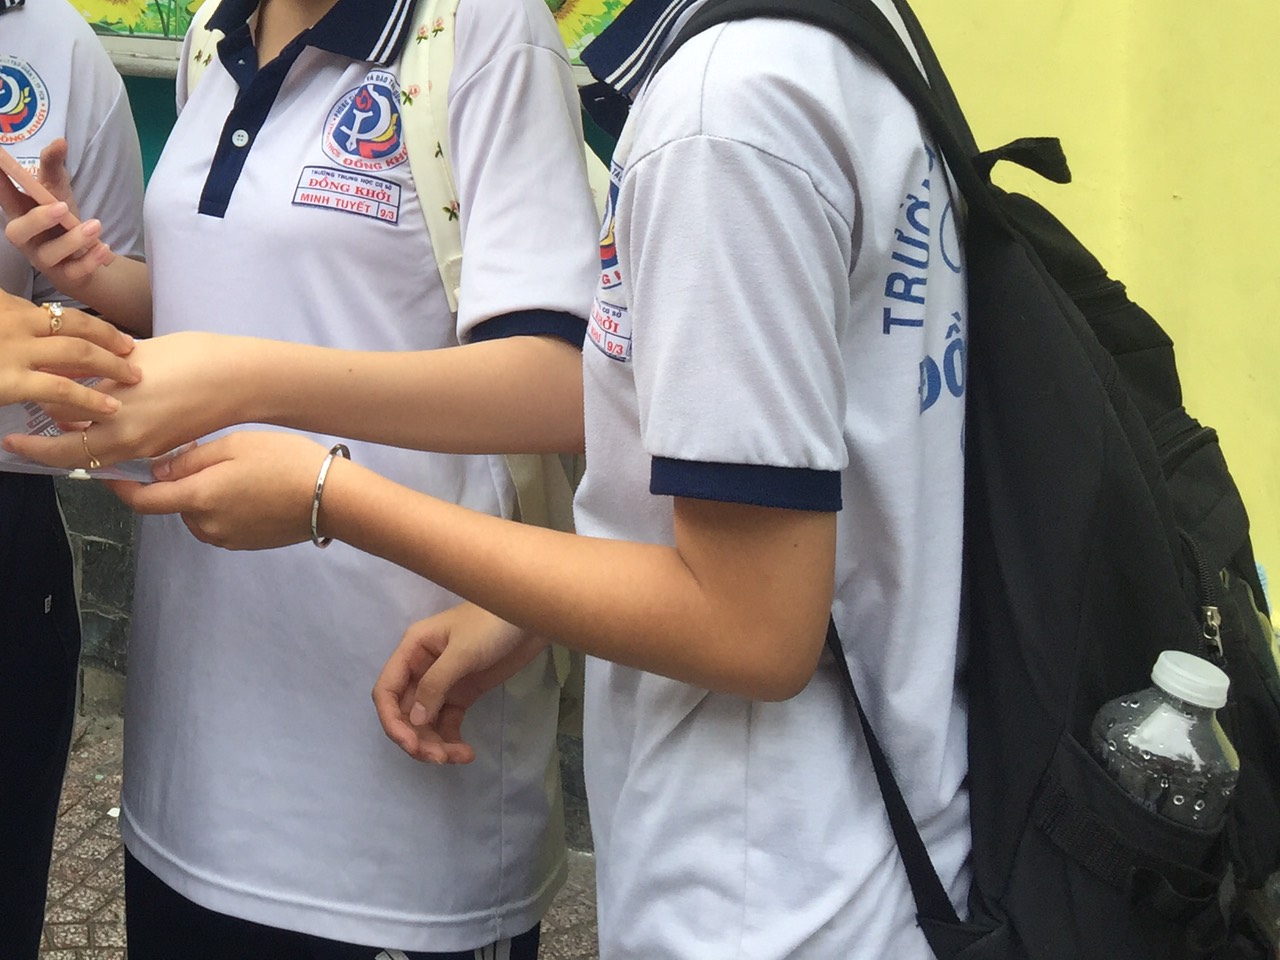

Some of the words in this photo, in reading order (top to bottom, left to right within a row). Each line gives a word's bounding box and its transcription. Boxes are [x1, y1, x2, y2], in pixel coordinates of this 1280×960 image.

[326, 142, 341, 157] THCS
[343, 157, 382, 170] ĐỒNG
[308, 177, 350, 193] ĐỒNG
[354, 186, 391, 203] KHỞI
[337, 174, 359, 182] TRUNG
[300, 193, 330, 205] MINH
[335, 198, 371, 214] TUYẾT
[380, 208, 395, 220] 9/3
[607, 341, 624, 355] 9/3
